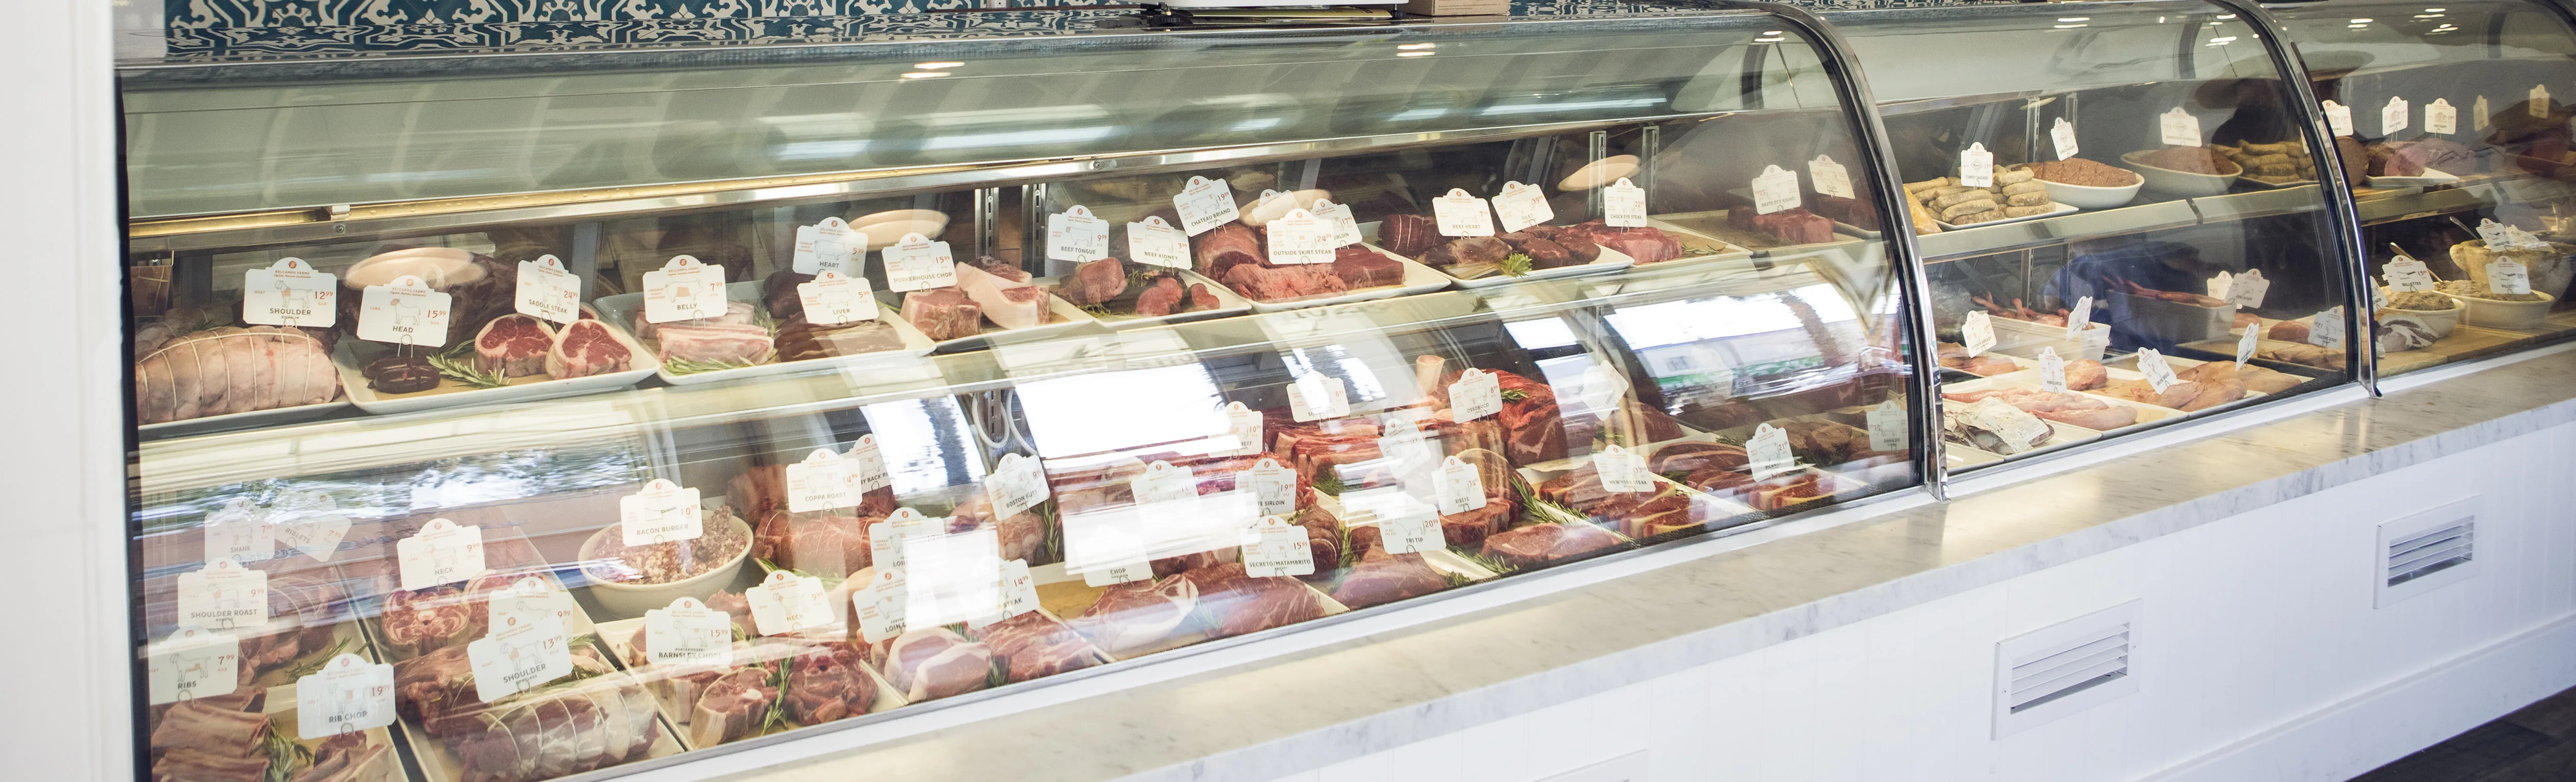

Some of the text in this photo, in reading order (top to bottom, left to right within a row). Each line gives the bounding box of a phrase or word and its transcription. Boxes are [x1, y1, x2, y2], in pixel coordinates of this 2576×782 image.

[1191, 215, 1213, 226] CHATEAU
[1213, 208, 1231, 218] BRIAND
[893, 274, 936, 285] PORKERHOUSE
[529, 298, 551, 310] SADDLE
[551, 304, 568, 314] STEAK
[677, 302, 697, 311] BELLY
[392, 325, 414, 334] HEAD
[1467, 402, 1490, 413] OSSOBUCO
[867, 473, 882, 483] BACK
[828, 491, 846, 500] ROAST
[1006, 494, 1025, 508] BOSTON
[1025, 489, 1037, 500] BUTT
[285, 527, 311, 543] RIBLETS
[636, 524, 689, 536] BACON BURGER
[230, 545, 251, 553] SHANK
[1249, 559, 1311, 568] SECRETO/MATAMBRITO
[434, 566, 454, 576] NECK
[1003, 597, 1023, 608] STEAK
[191, 610, 232, 619] SHOULDER
[786, 613, 804, 622] NECK
[885, 624, 901, 633] LOIN
[503, 663, 547, 683] SHOULDER
[515, 674, 538, 685] BONELESS
[177, 680, 197, 690] RIBS
[329, 710, 368, 724] RIB CHOP
